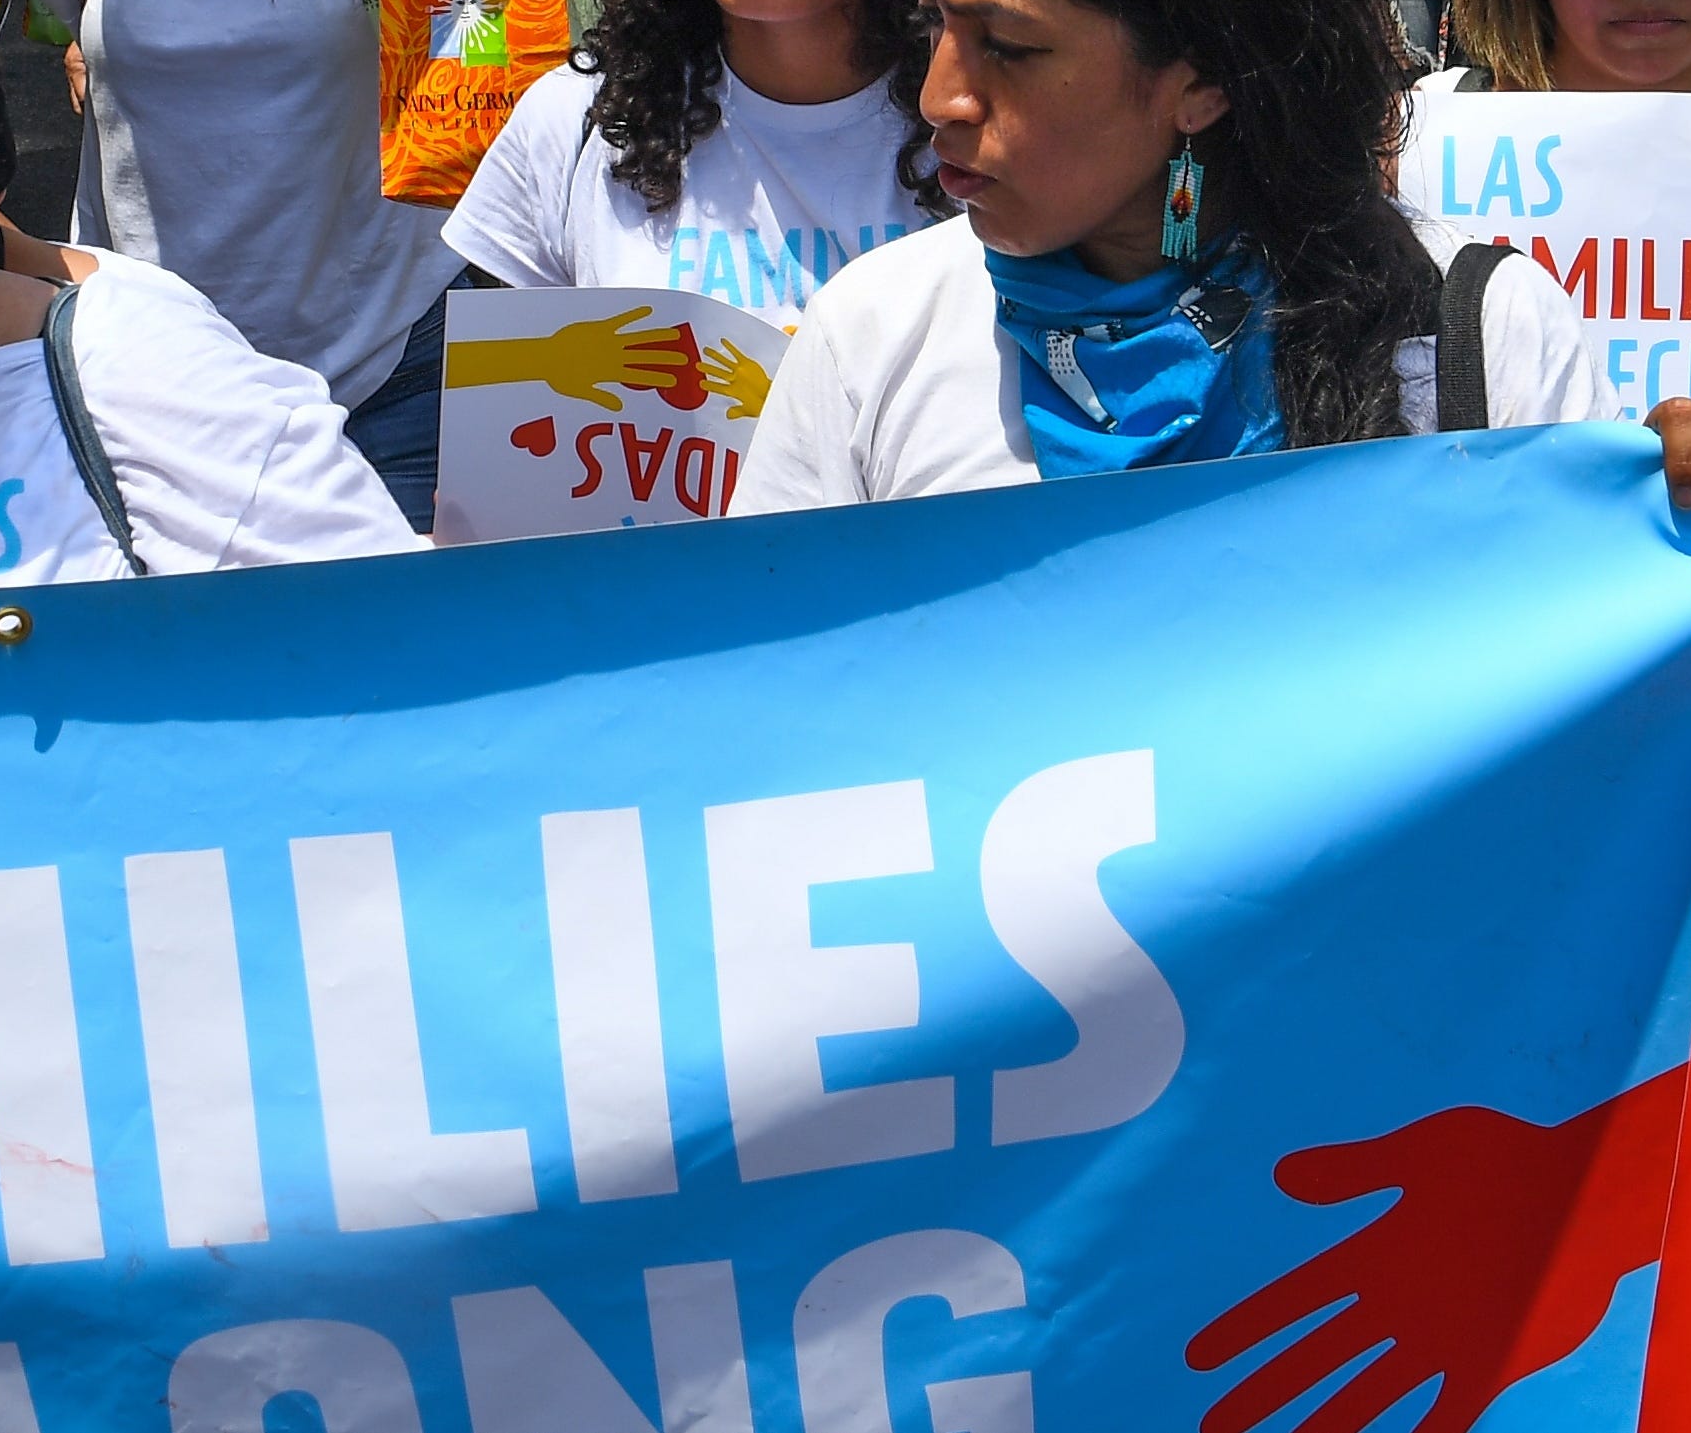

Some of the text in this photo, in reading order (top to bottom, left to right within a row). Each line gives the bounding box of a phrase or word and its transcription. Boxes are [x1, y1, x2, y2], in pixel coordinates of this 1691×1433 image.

[454, 84, 516, 113] GERM
[1441, 135, 1563, 218] LAS
[570, 422, 740, 519] IDAS
